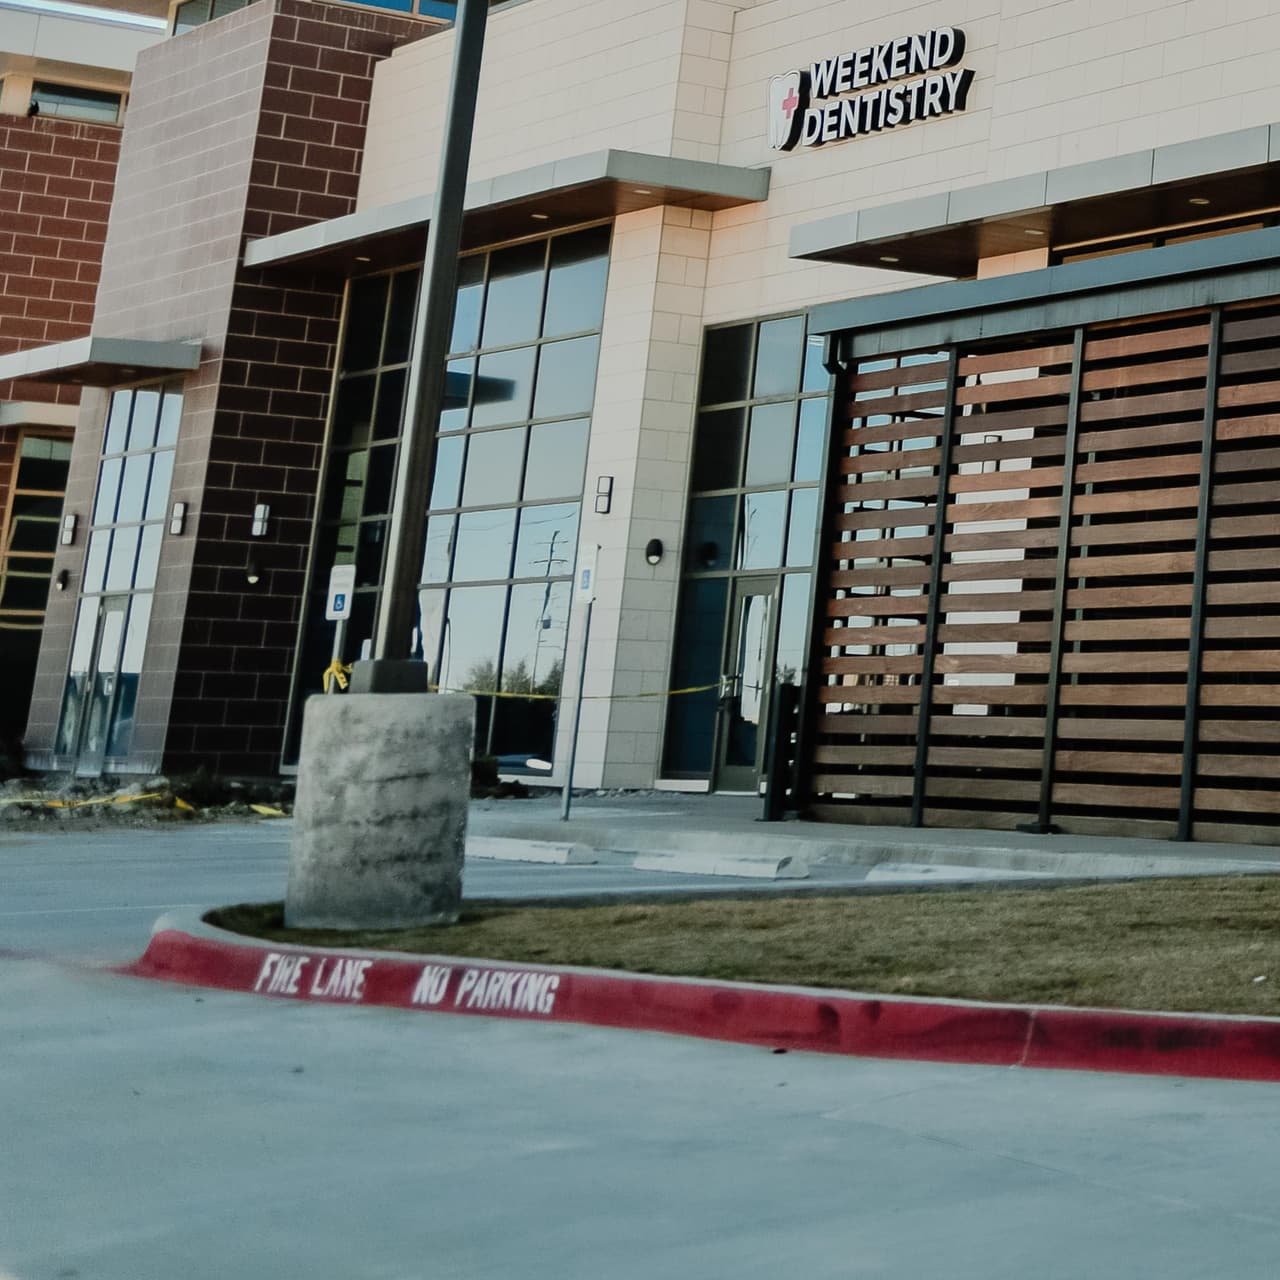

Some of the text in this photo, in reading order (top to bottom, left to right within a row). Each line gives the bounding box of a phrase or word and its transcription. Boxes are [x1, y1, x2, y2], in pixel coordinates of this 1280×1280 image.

[810, 26, 967, 100] WEEKEND
[801, 68, 976, 147] DENTISTRY
[254, 952, 374, 1000] FIRE LANE
[412, 964, 561, 1014] NO PARKING
